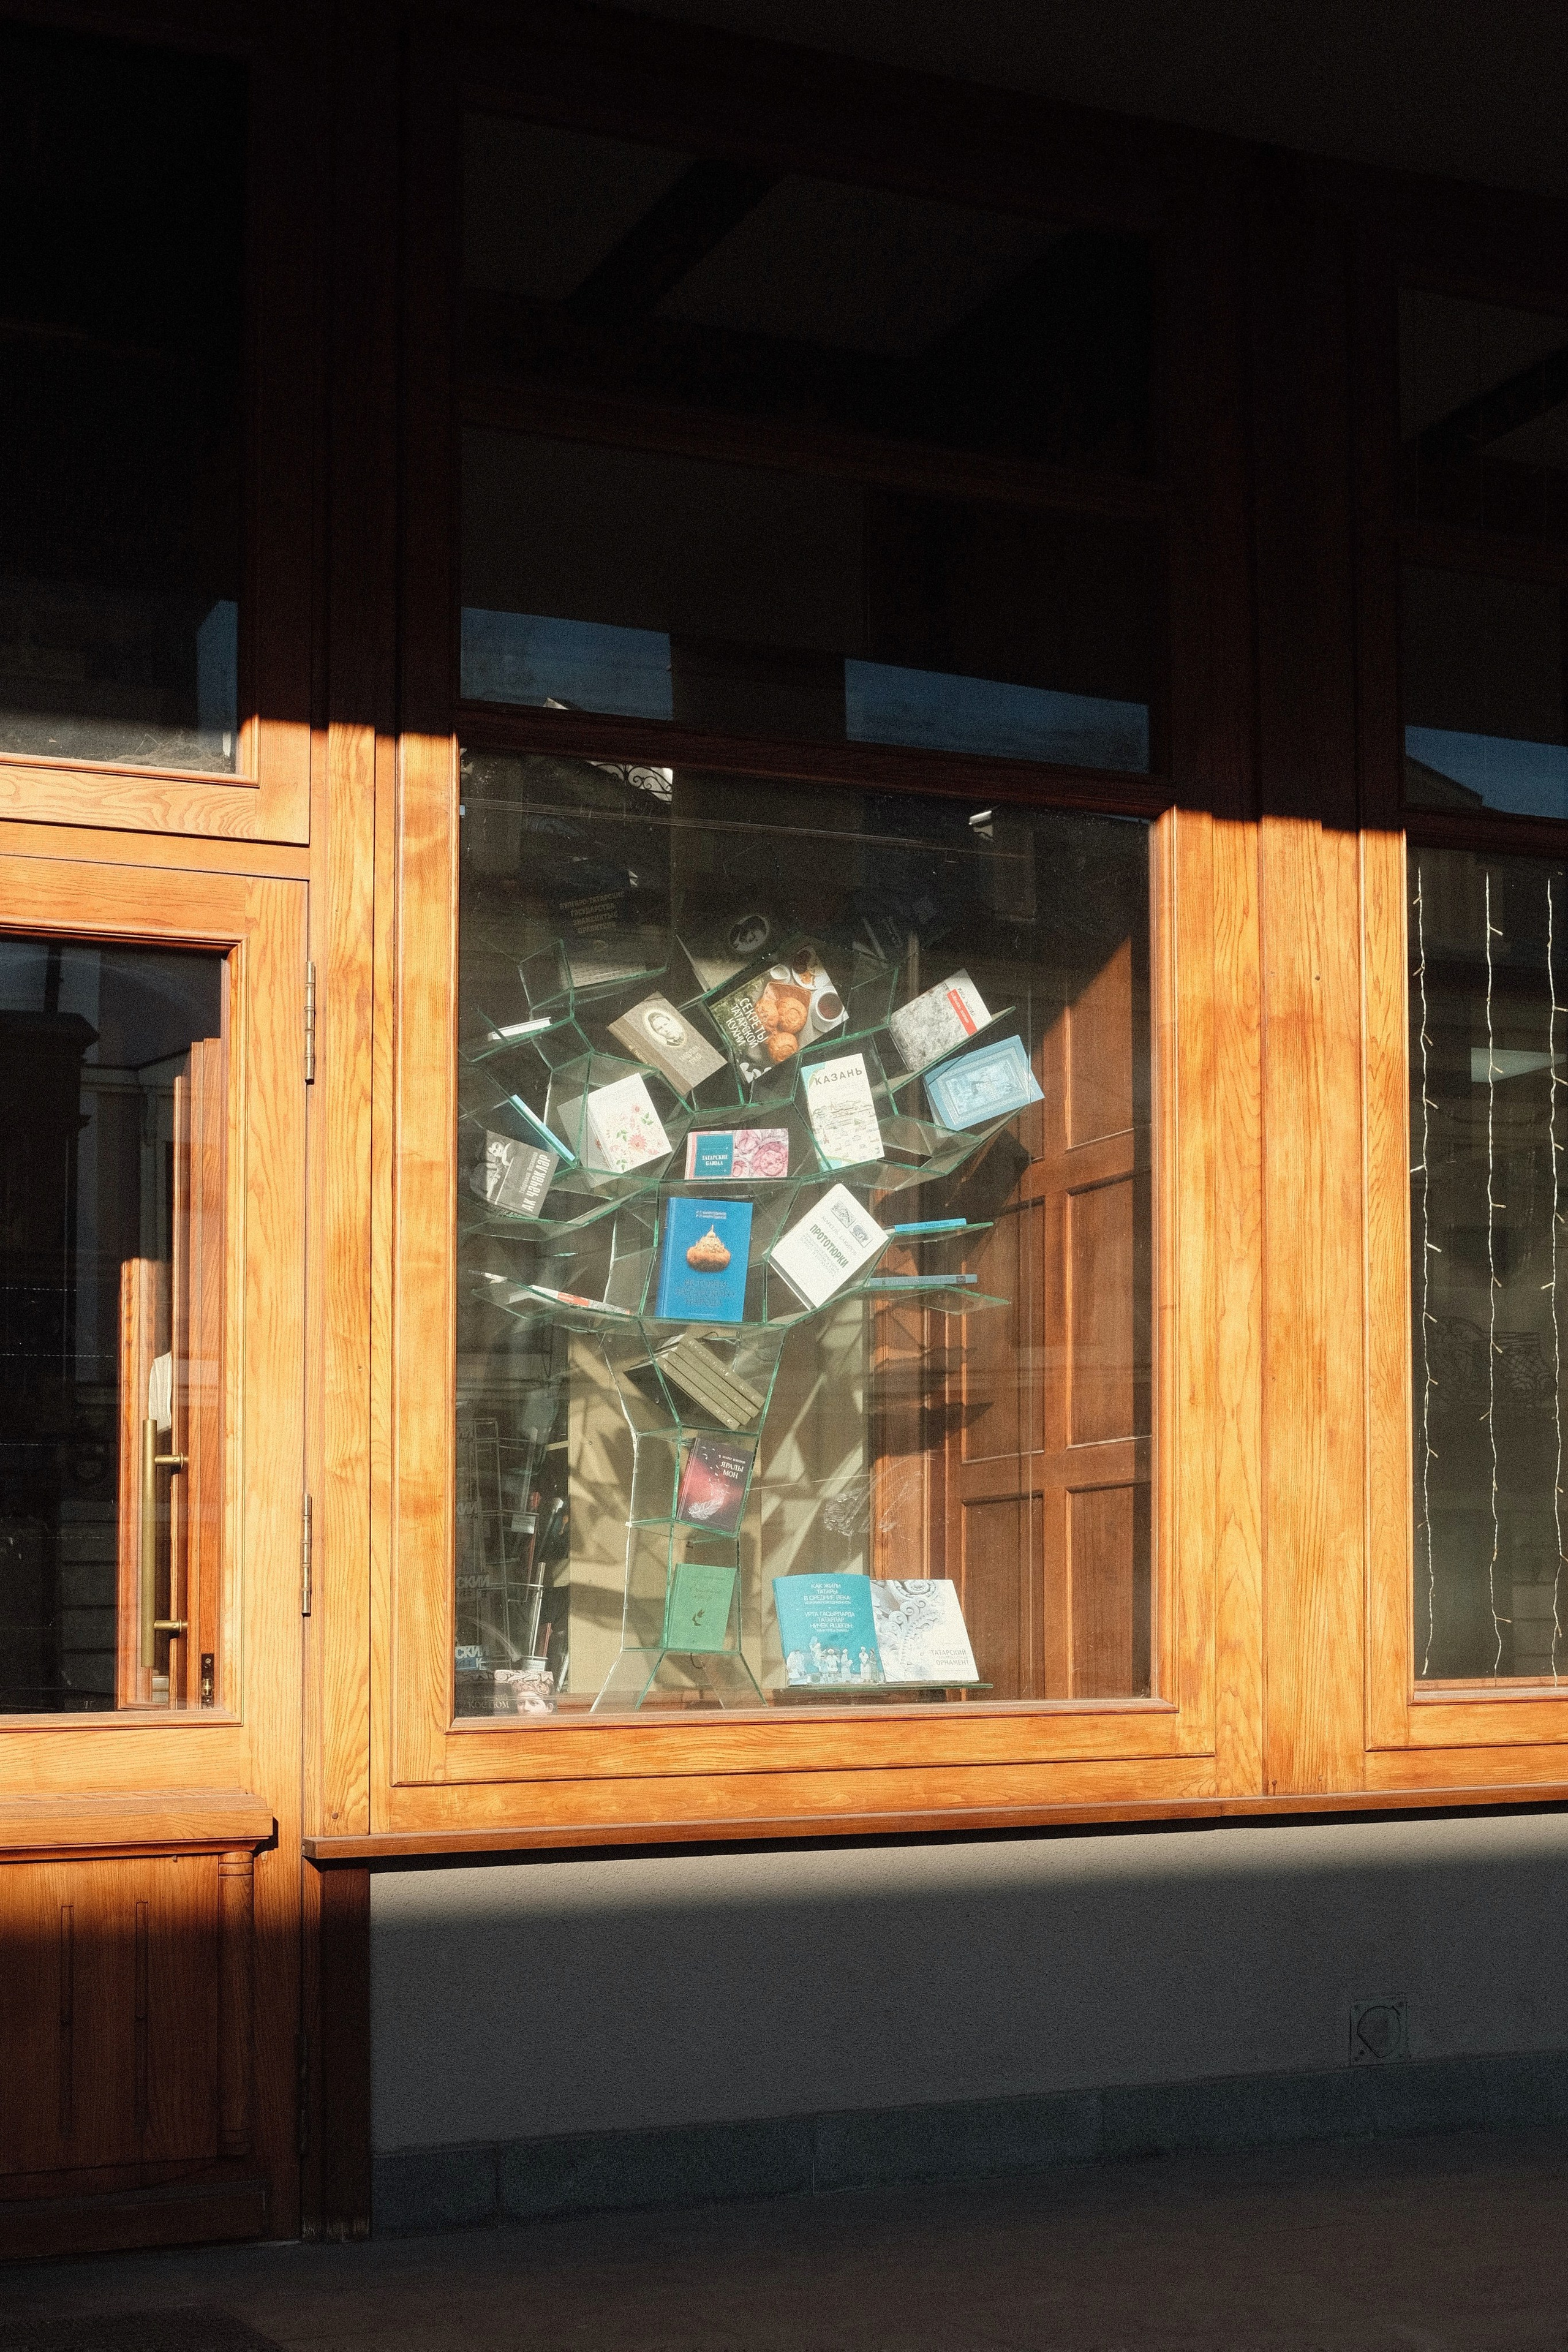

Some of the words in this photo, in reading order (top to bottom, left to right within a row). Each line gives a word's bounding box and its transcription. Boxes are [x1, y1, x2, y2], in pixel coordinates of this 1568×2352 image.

[726, 1017, 746, 1046] КУХНИ
[731, 1003, 760, 1049] ТАТАРСКОЙ
[739, 998, 769, 1042] СЕКРЕТЫ
[815, 1068, 862, 1085] КАЗАНЬ
[526, 1154, 551, 1197] ЧӘЧӘКЛӘР
[521, 1197, 537, 1212] АК
[809, 1223, 849, 1268] ПРОТОТЮРКИ
[720, 1460, 745, 1472] ЯРАЛЫ
[723, 1469, 739, 1479] МОН
